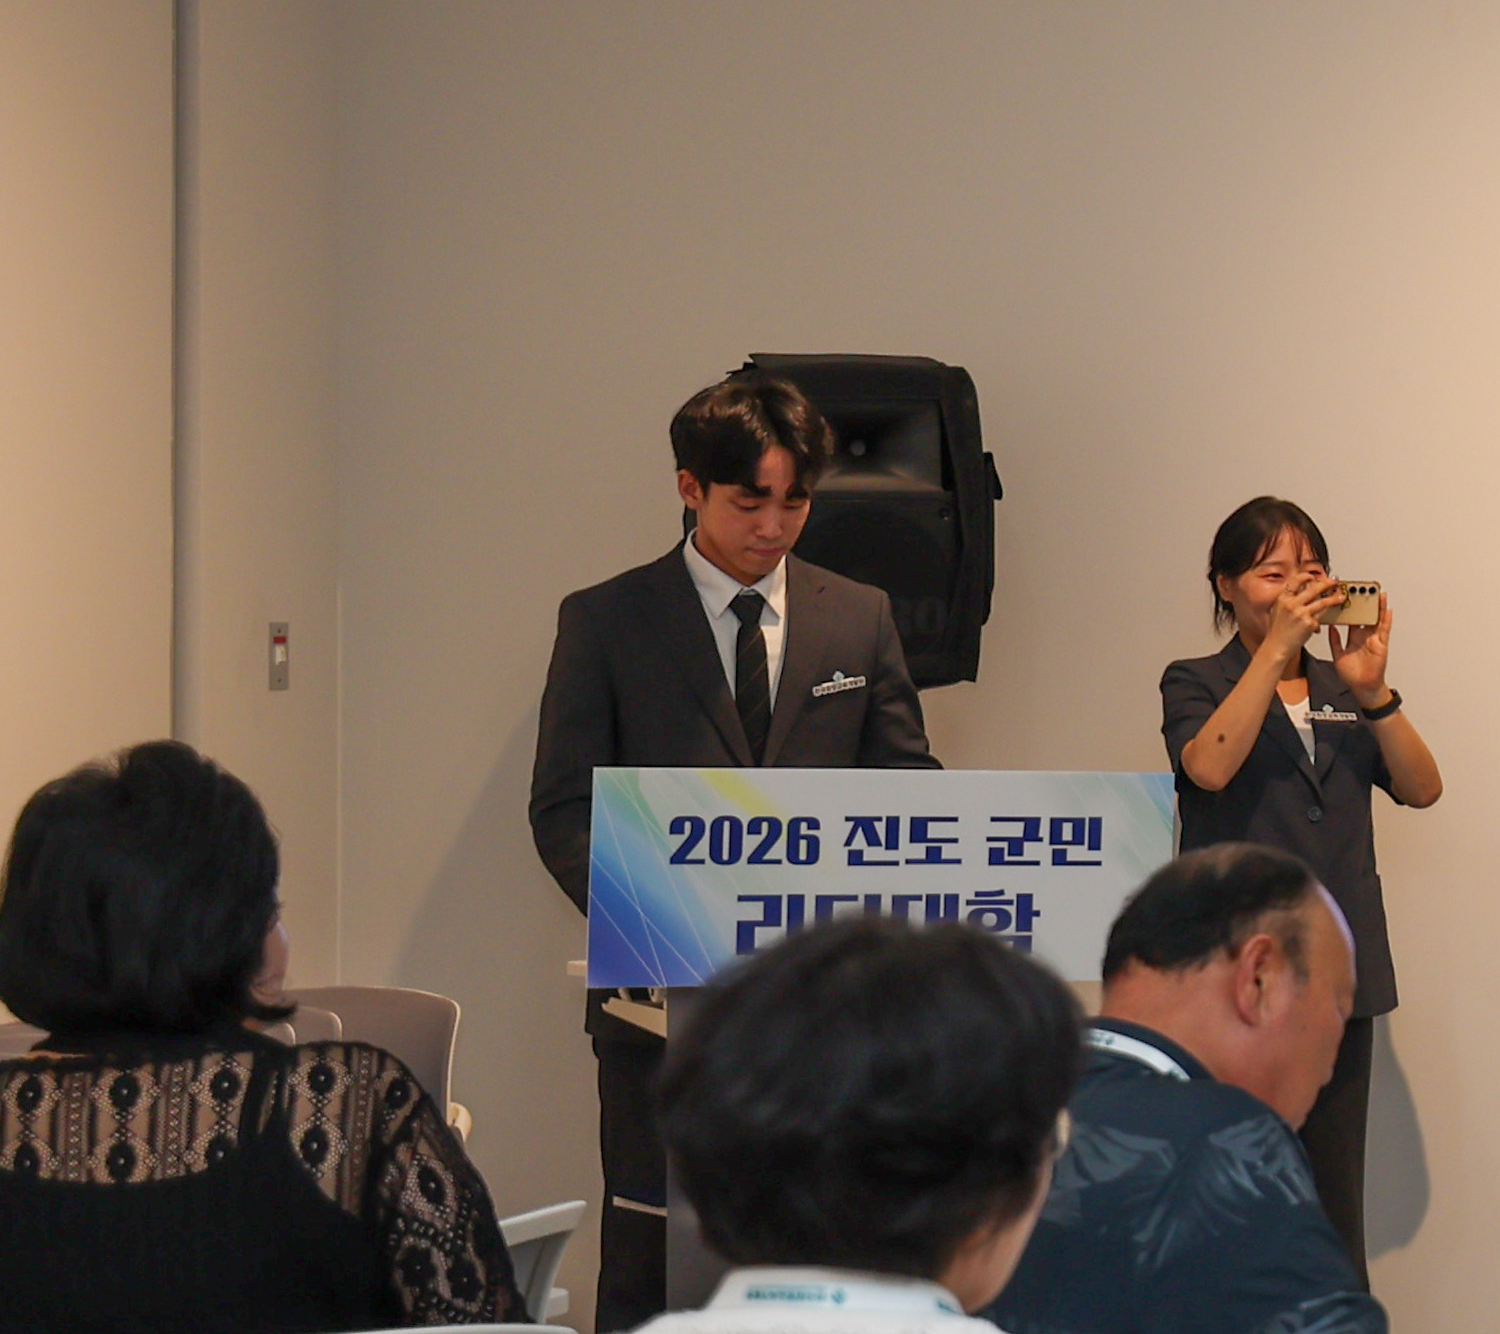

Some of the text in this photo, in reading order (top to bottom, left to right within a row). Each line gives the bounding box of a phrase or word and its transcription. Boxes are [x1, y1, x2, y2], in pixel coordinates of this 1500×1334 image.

[668, 814, 1103, 867] 2026 진도 군민
